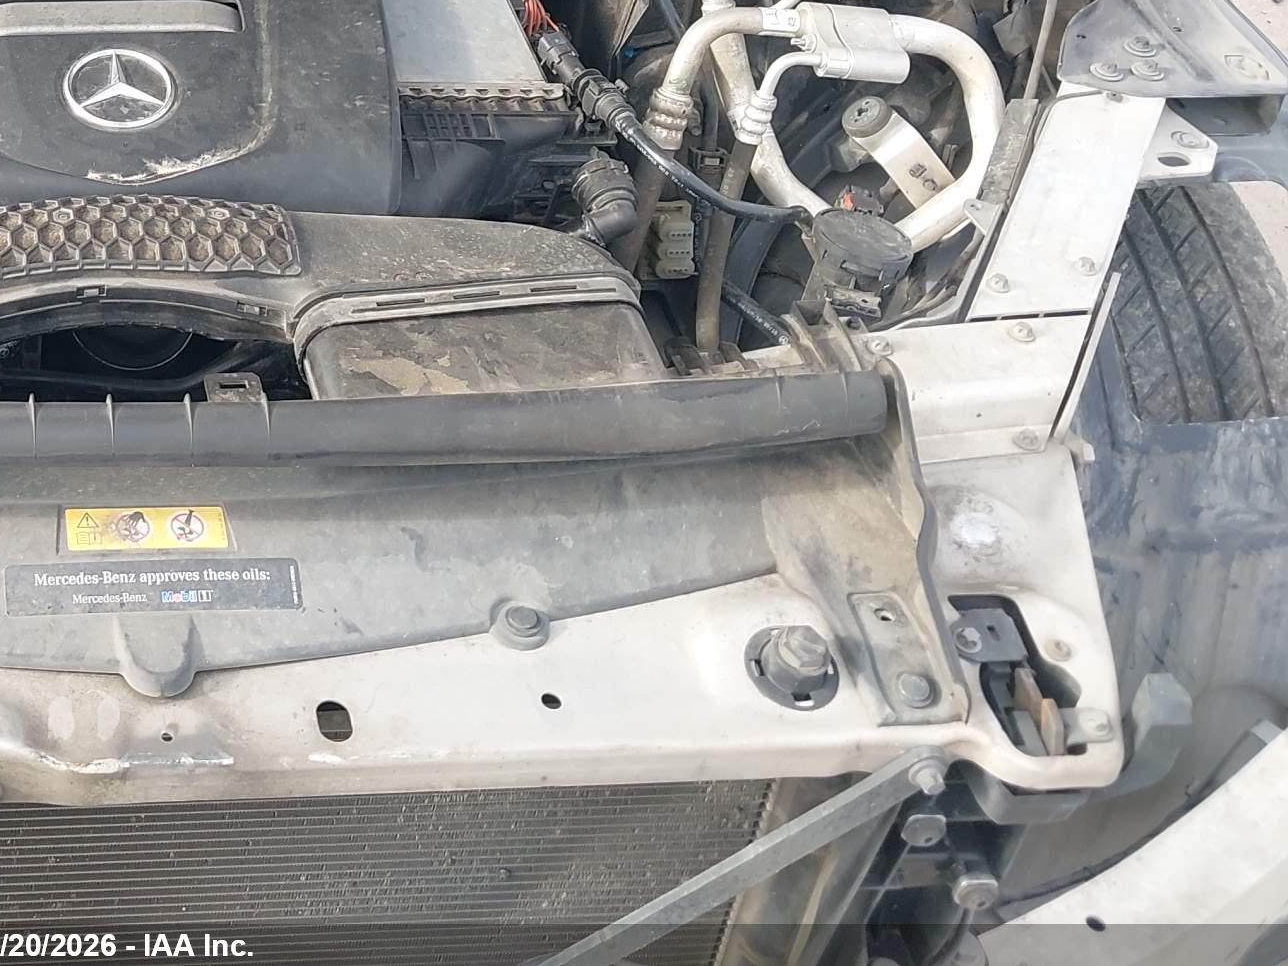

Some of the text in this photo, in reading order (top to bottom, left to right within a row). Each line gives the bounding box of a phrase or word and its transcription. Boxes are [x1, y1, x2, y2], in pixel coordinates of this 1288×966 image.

[33, 568, 272, 587] Mercedes-Benz approves these oils:
[71, 592, 148, 605] Mercedes-Benz
[161, 590, 197, 603] Mobil
